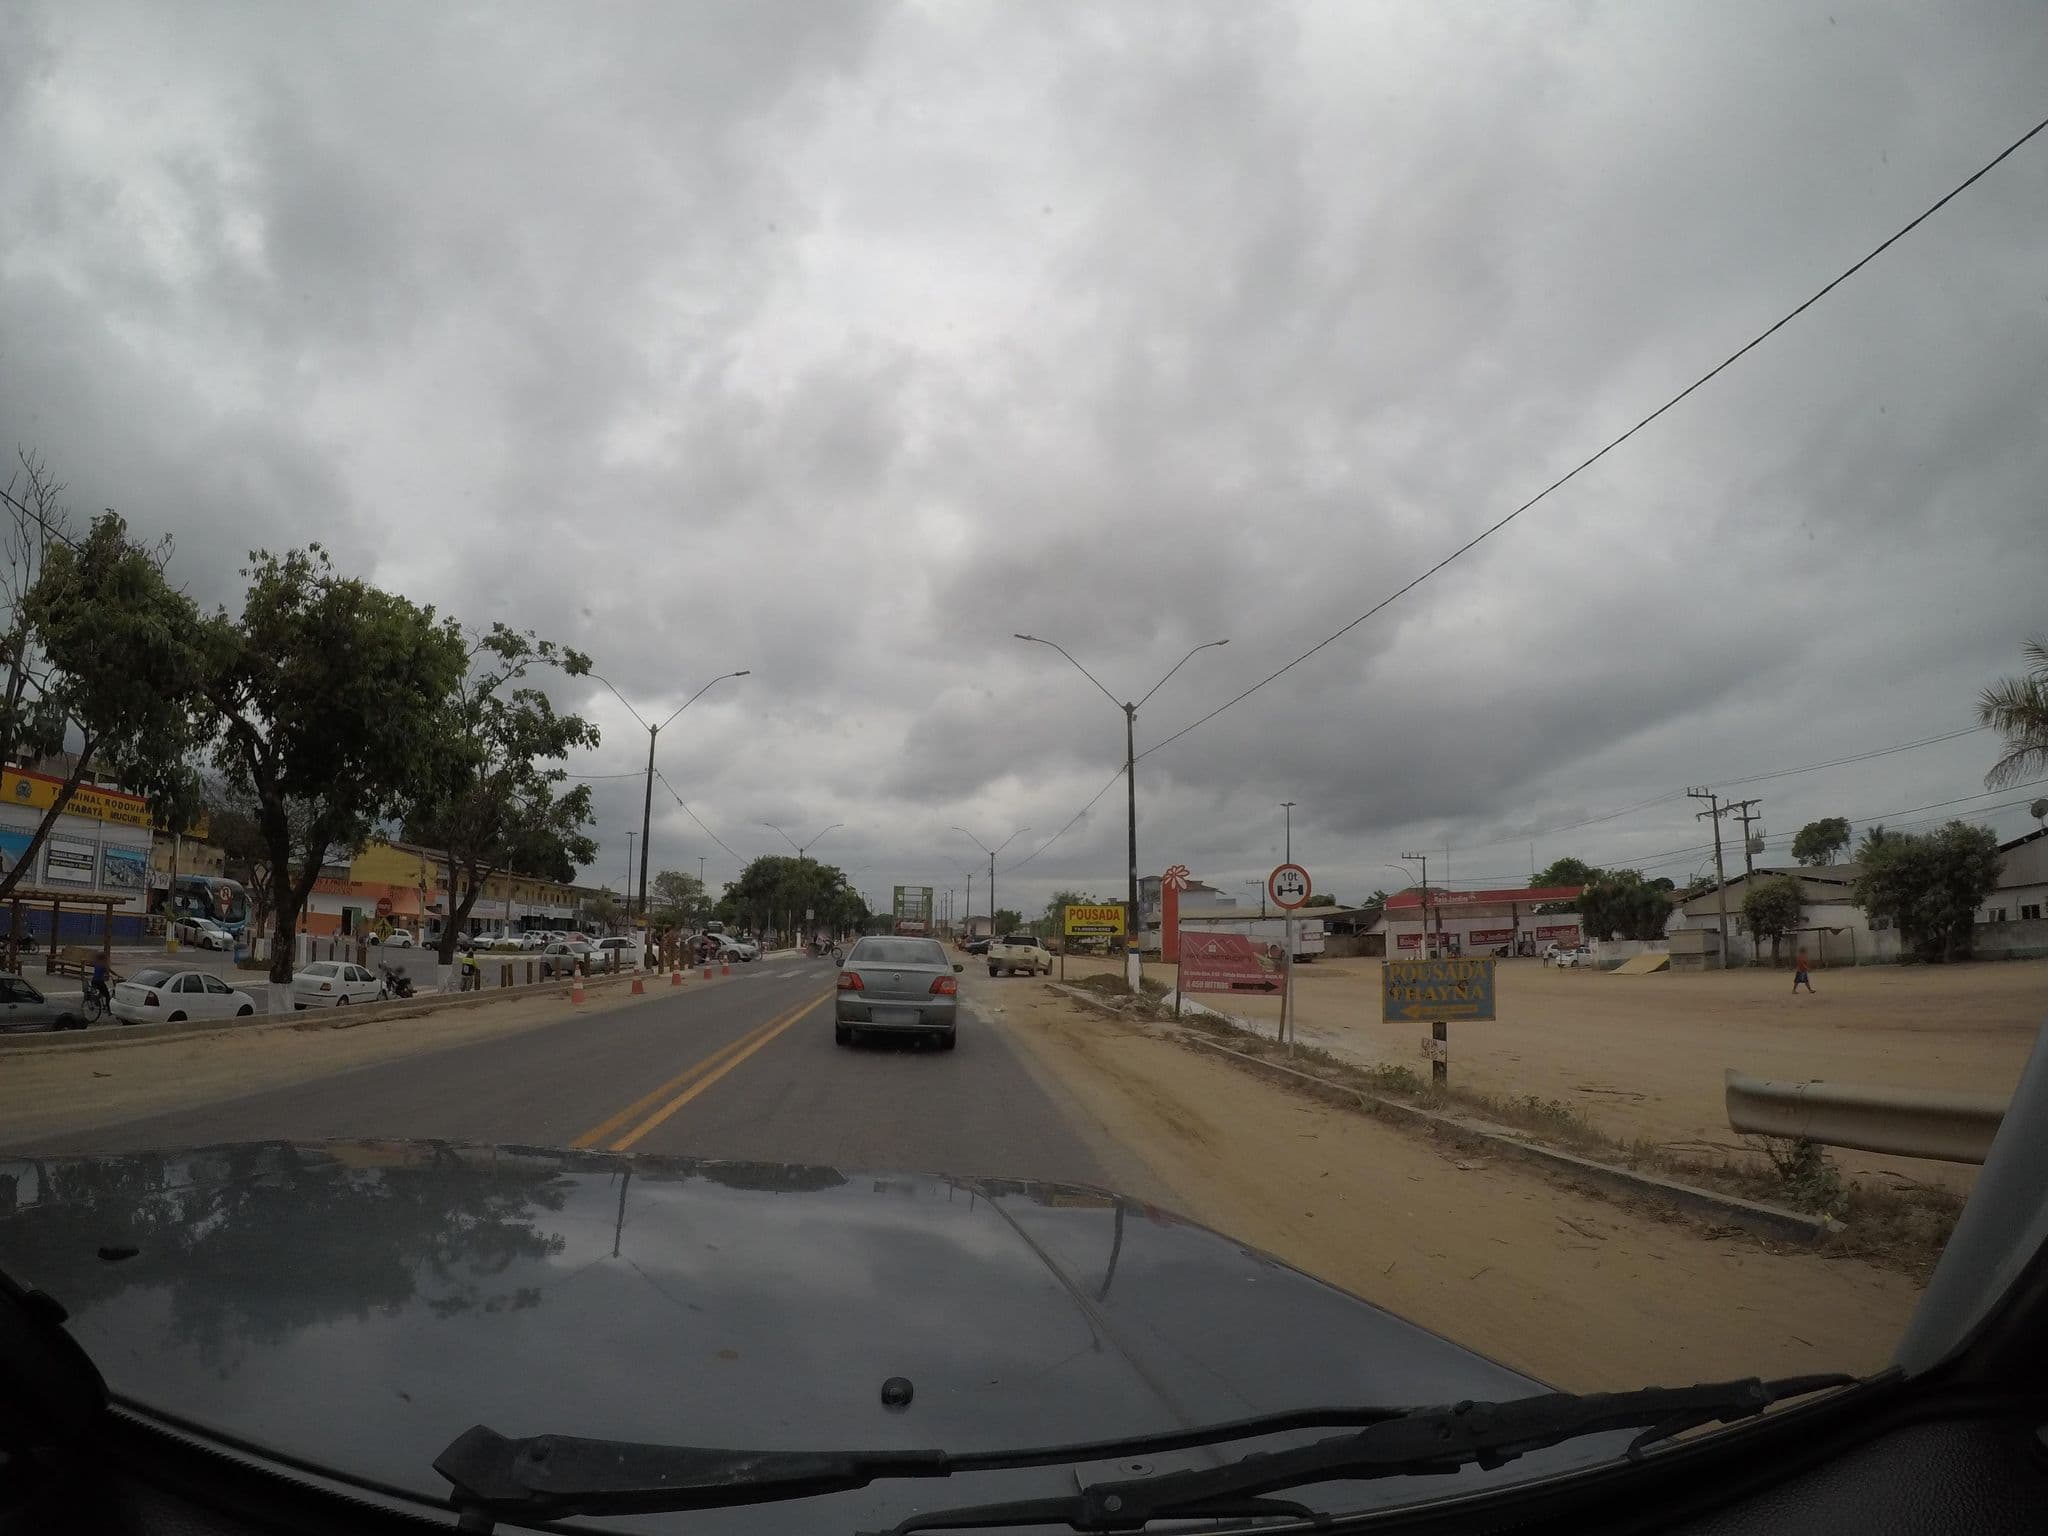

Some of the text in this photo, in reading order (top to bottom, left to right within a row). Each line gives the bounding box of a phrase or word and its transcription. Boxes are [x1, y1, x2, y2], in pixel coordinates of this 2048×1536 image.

[1282, 872, 1298, 881] 10t
[1069, 908, 1121, 921] POUSADA
[1390, 963, 1486, 980] POUSADA
